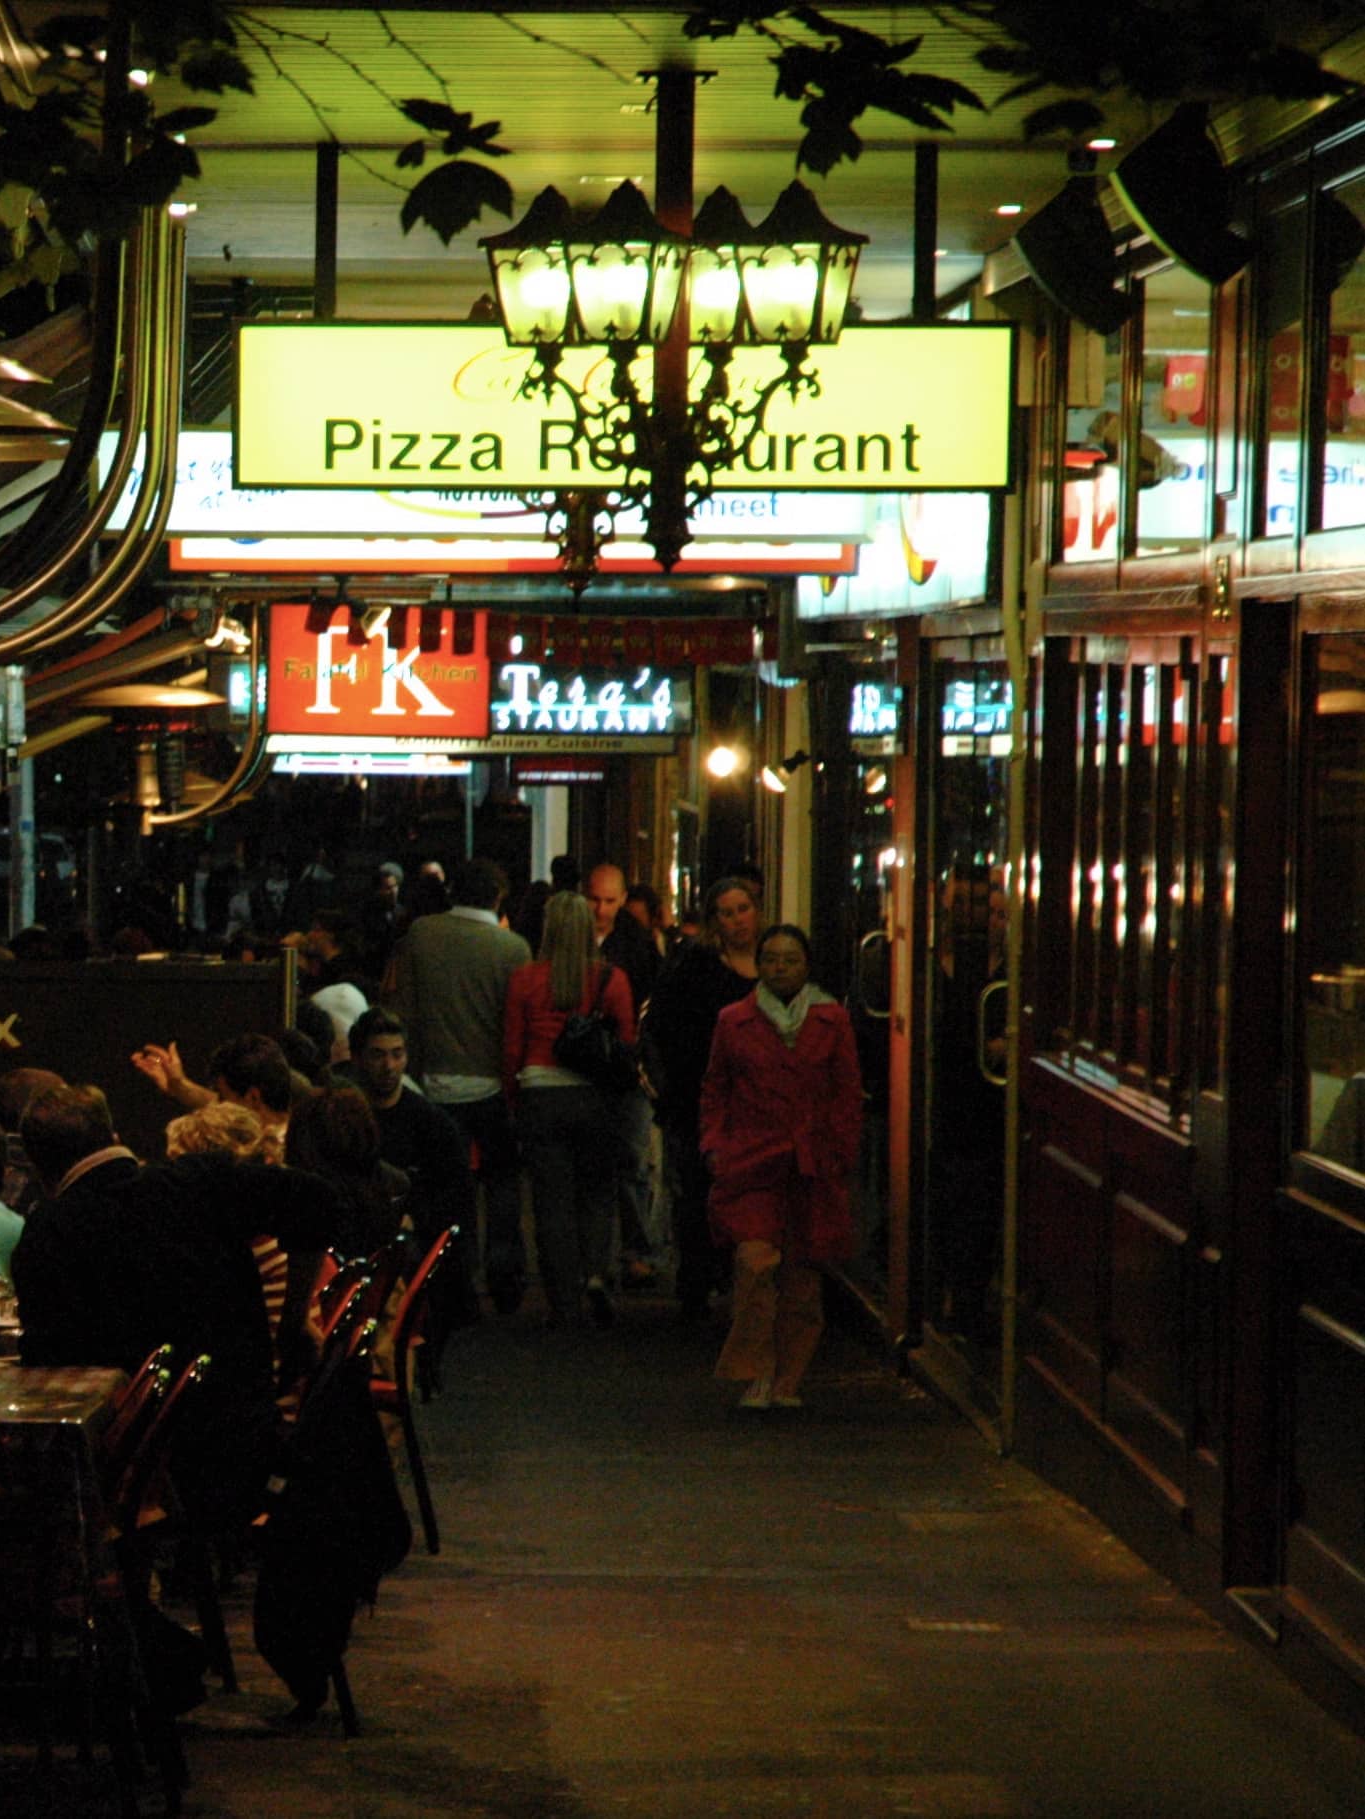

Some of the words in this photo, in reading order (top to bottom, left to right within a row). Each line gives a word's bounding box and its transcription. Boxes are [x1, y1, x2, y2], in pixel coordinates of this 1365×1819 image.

[324, 419, 503, 471] Pizza
[539, 420, 921, 473] Reurant
[496, 705, 673, 732] STAURANT
